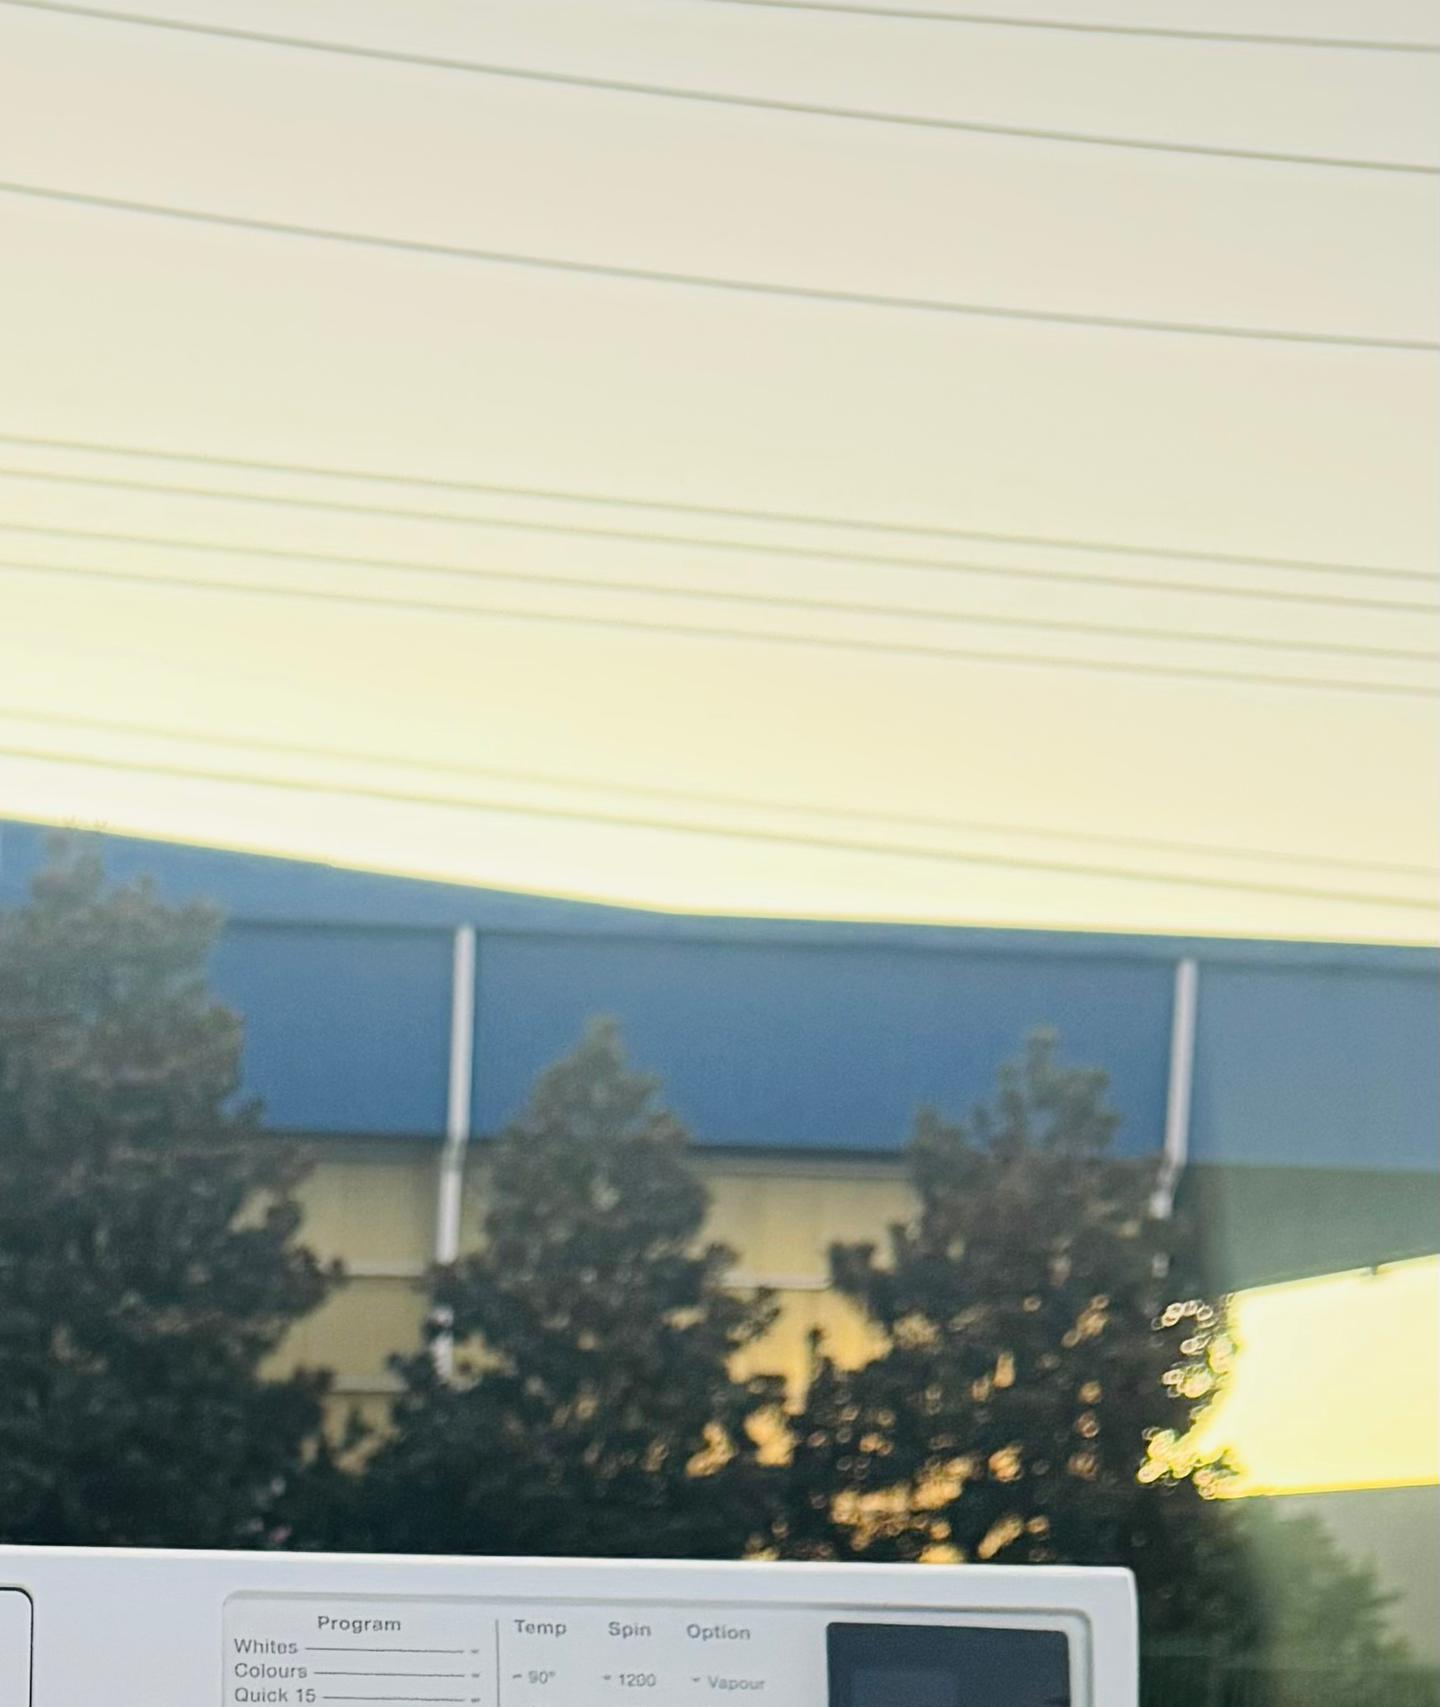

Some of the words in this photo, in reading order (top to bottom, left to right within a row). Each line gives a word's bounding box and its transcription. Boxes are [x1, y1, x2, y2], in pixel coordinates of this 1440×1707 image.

[317, 1615, 402, 1634] Program
[514, 1619, 567, 1638] Temp
[608, 1621, 652, 1639] Spin
[686, 1623, 751, 1643] Option
[233, 1638, 299, 1655] Whites
[233, 1663, 308, 1679] Colours
[619, 1673, 657, 1687] 1200
[708, 1676, 765, 1692] Vapour
[234, 1688, 289, 1704] Quick
[296, 1688, 316, 1704] 15
